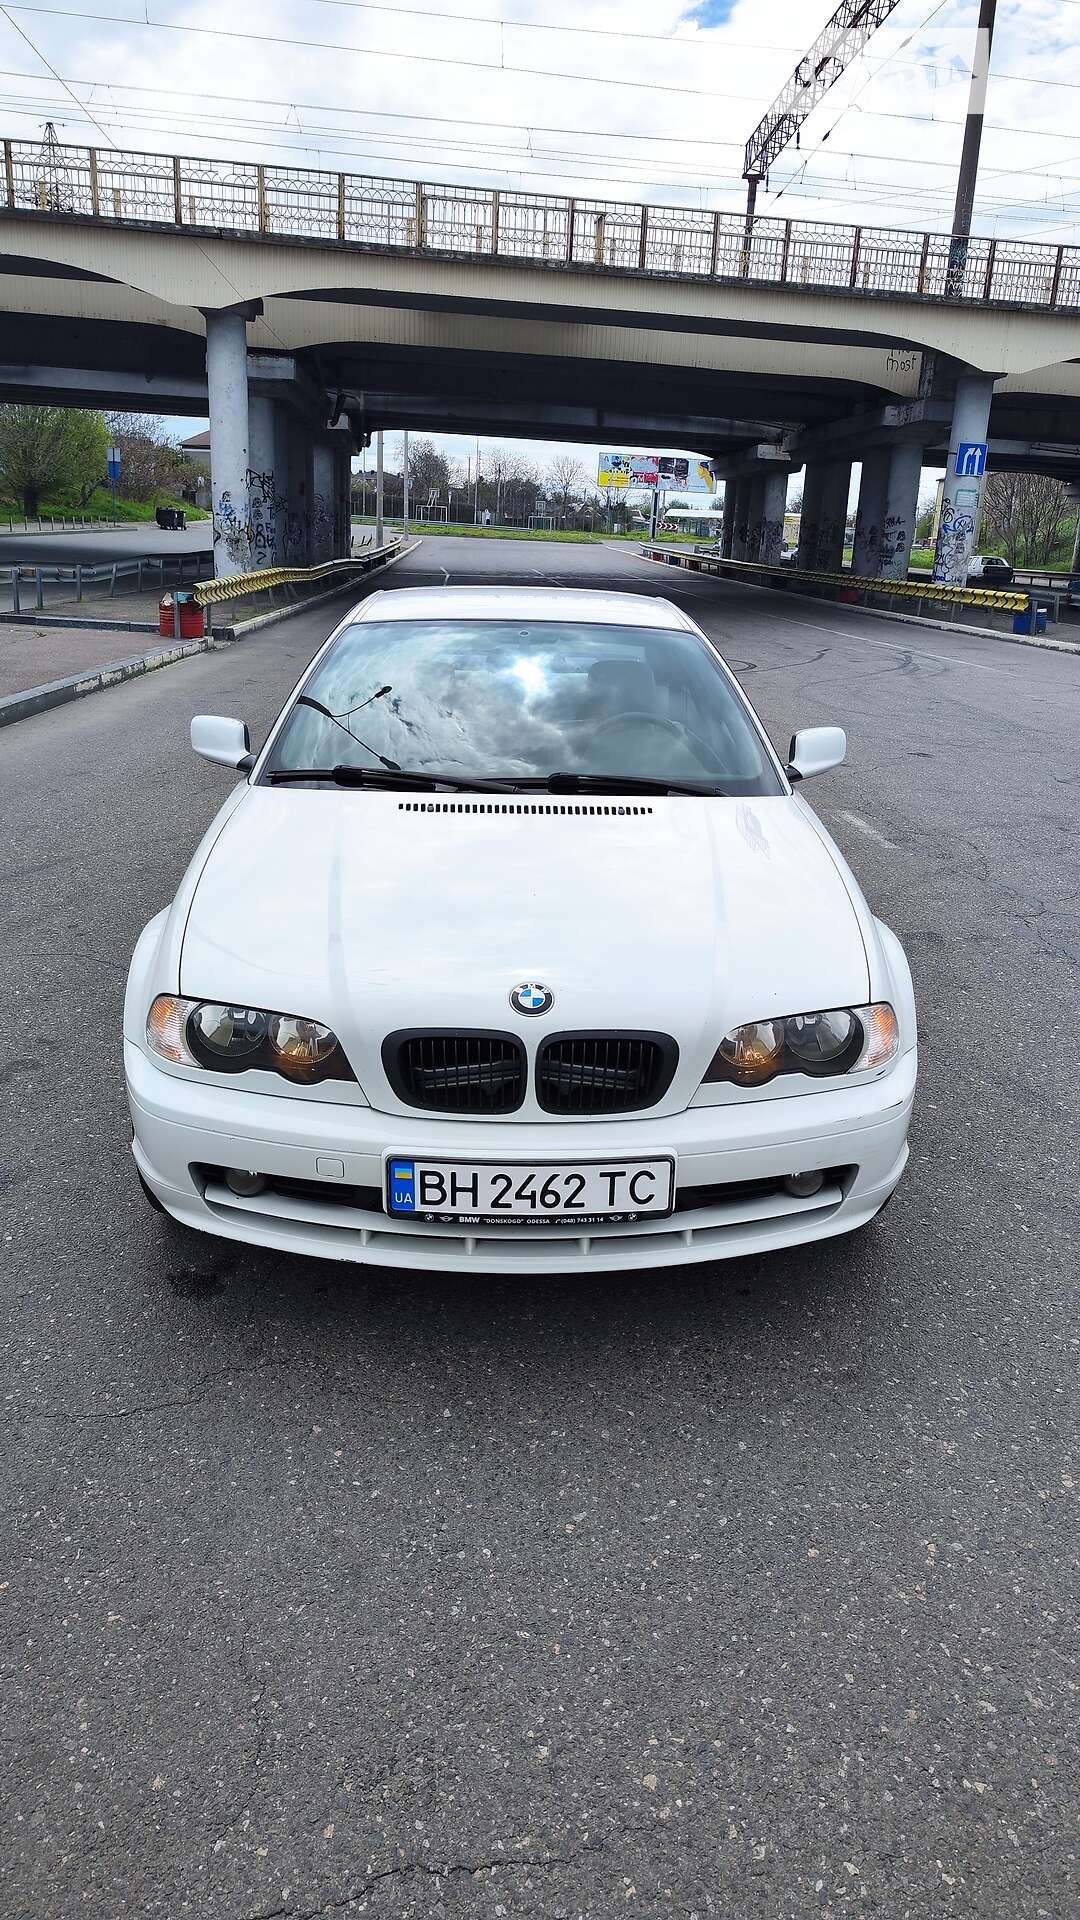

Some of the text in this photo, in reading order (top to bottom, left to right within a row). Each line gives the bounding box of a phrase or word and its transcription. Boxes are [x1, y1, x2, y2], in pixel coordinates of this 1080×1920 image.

[419, 1170, 656, 1209] BH 2462 TC
[395, 1191, 413, 1204] UA
[459, 1216, 480, 1224] BMW
